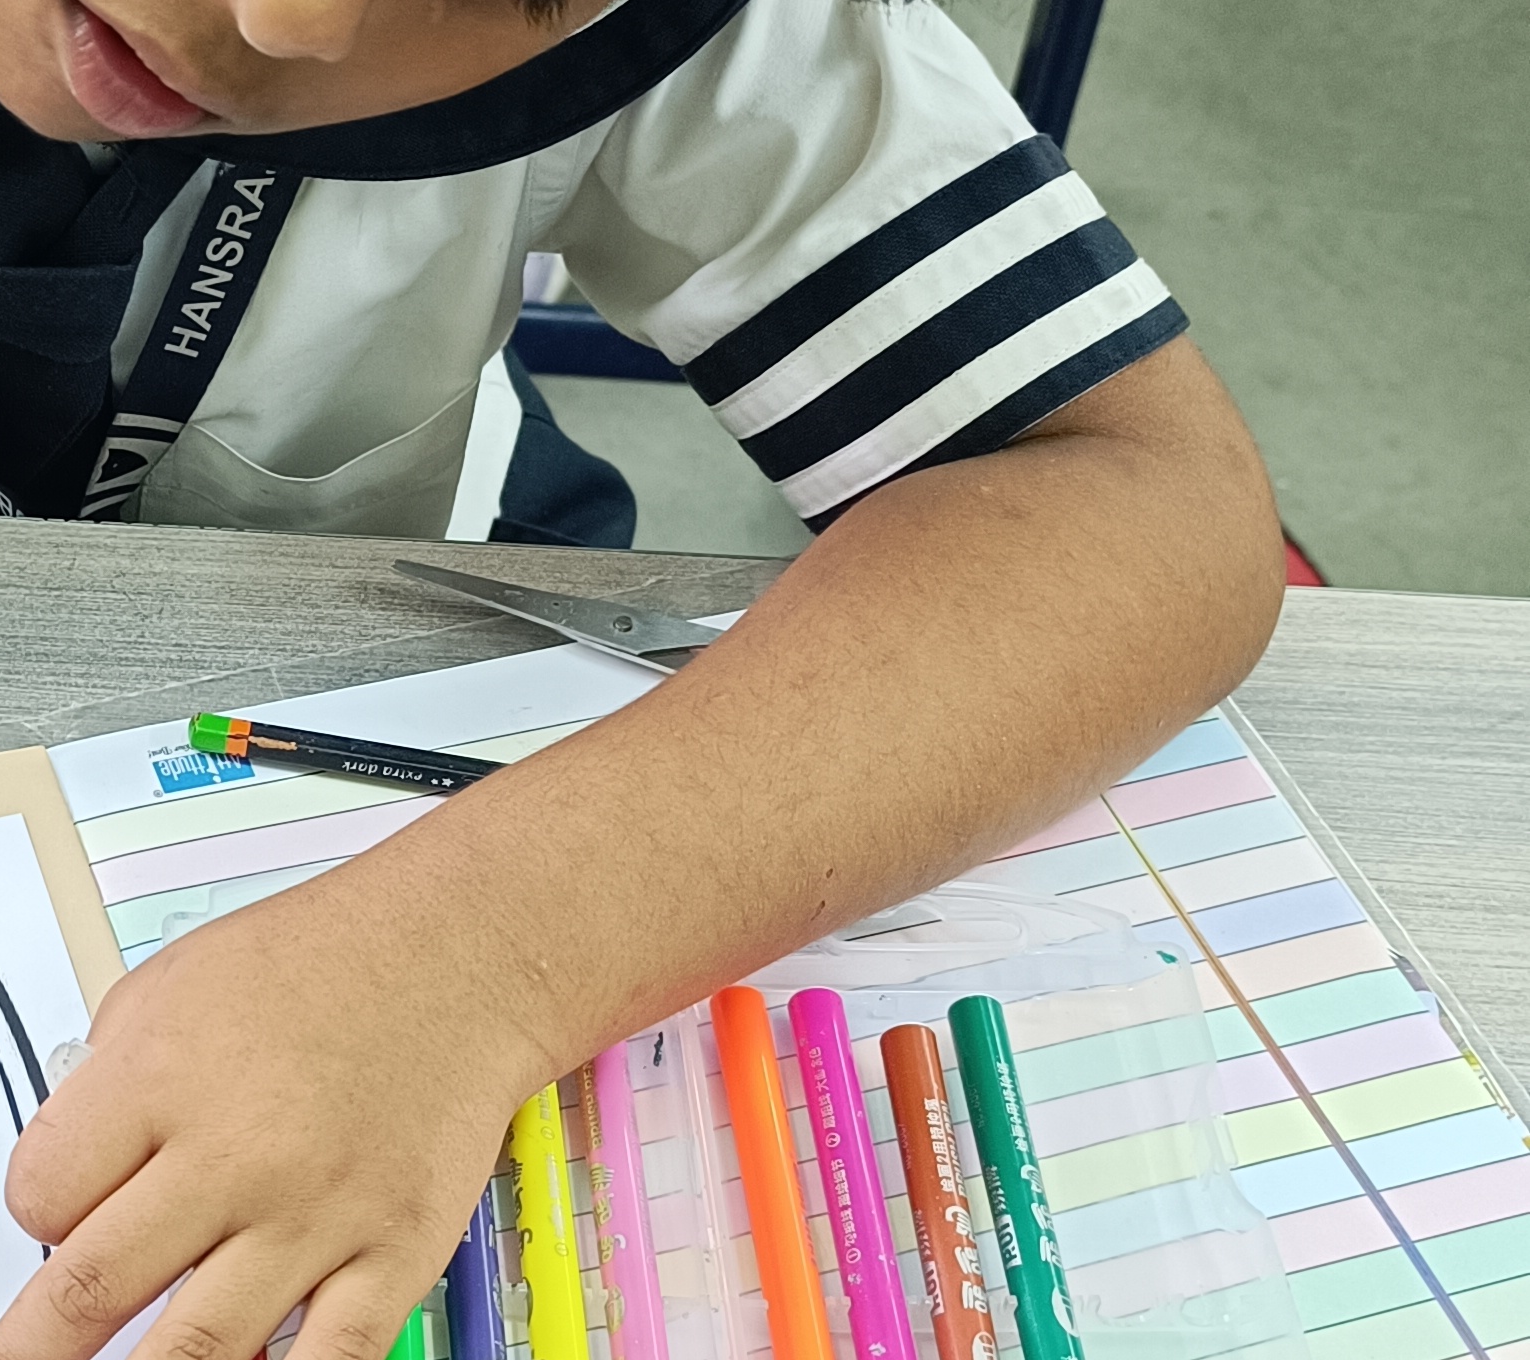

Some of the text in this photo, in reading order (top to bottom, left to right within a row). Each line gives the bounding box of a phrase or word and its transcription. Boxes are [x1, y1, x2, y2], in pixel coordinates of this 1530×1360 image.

[163, 169, 277, 358] HANSRA
[341, 760, 423, 782] extra dark
[585, 1093, 604, 1150] BRUSH
